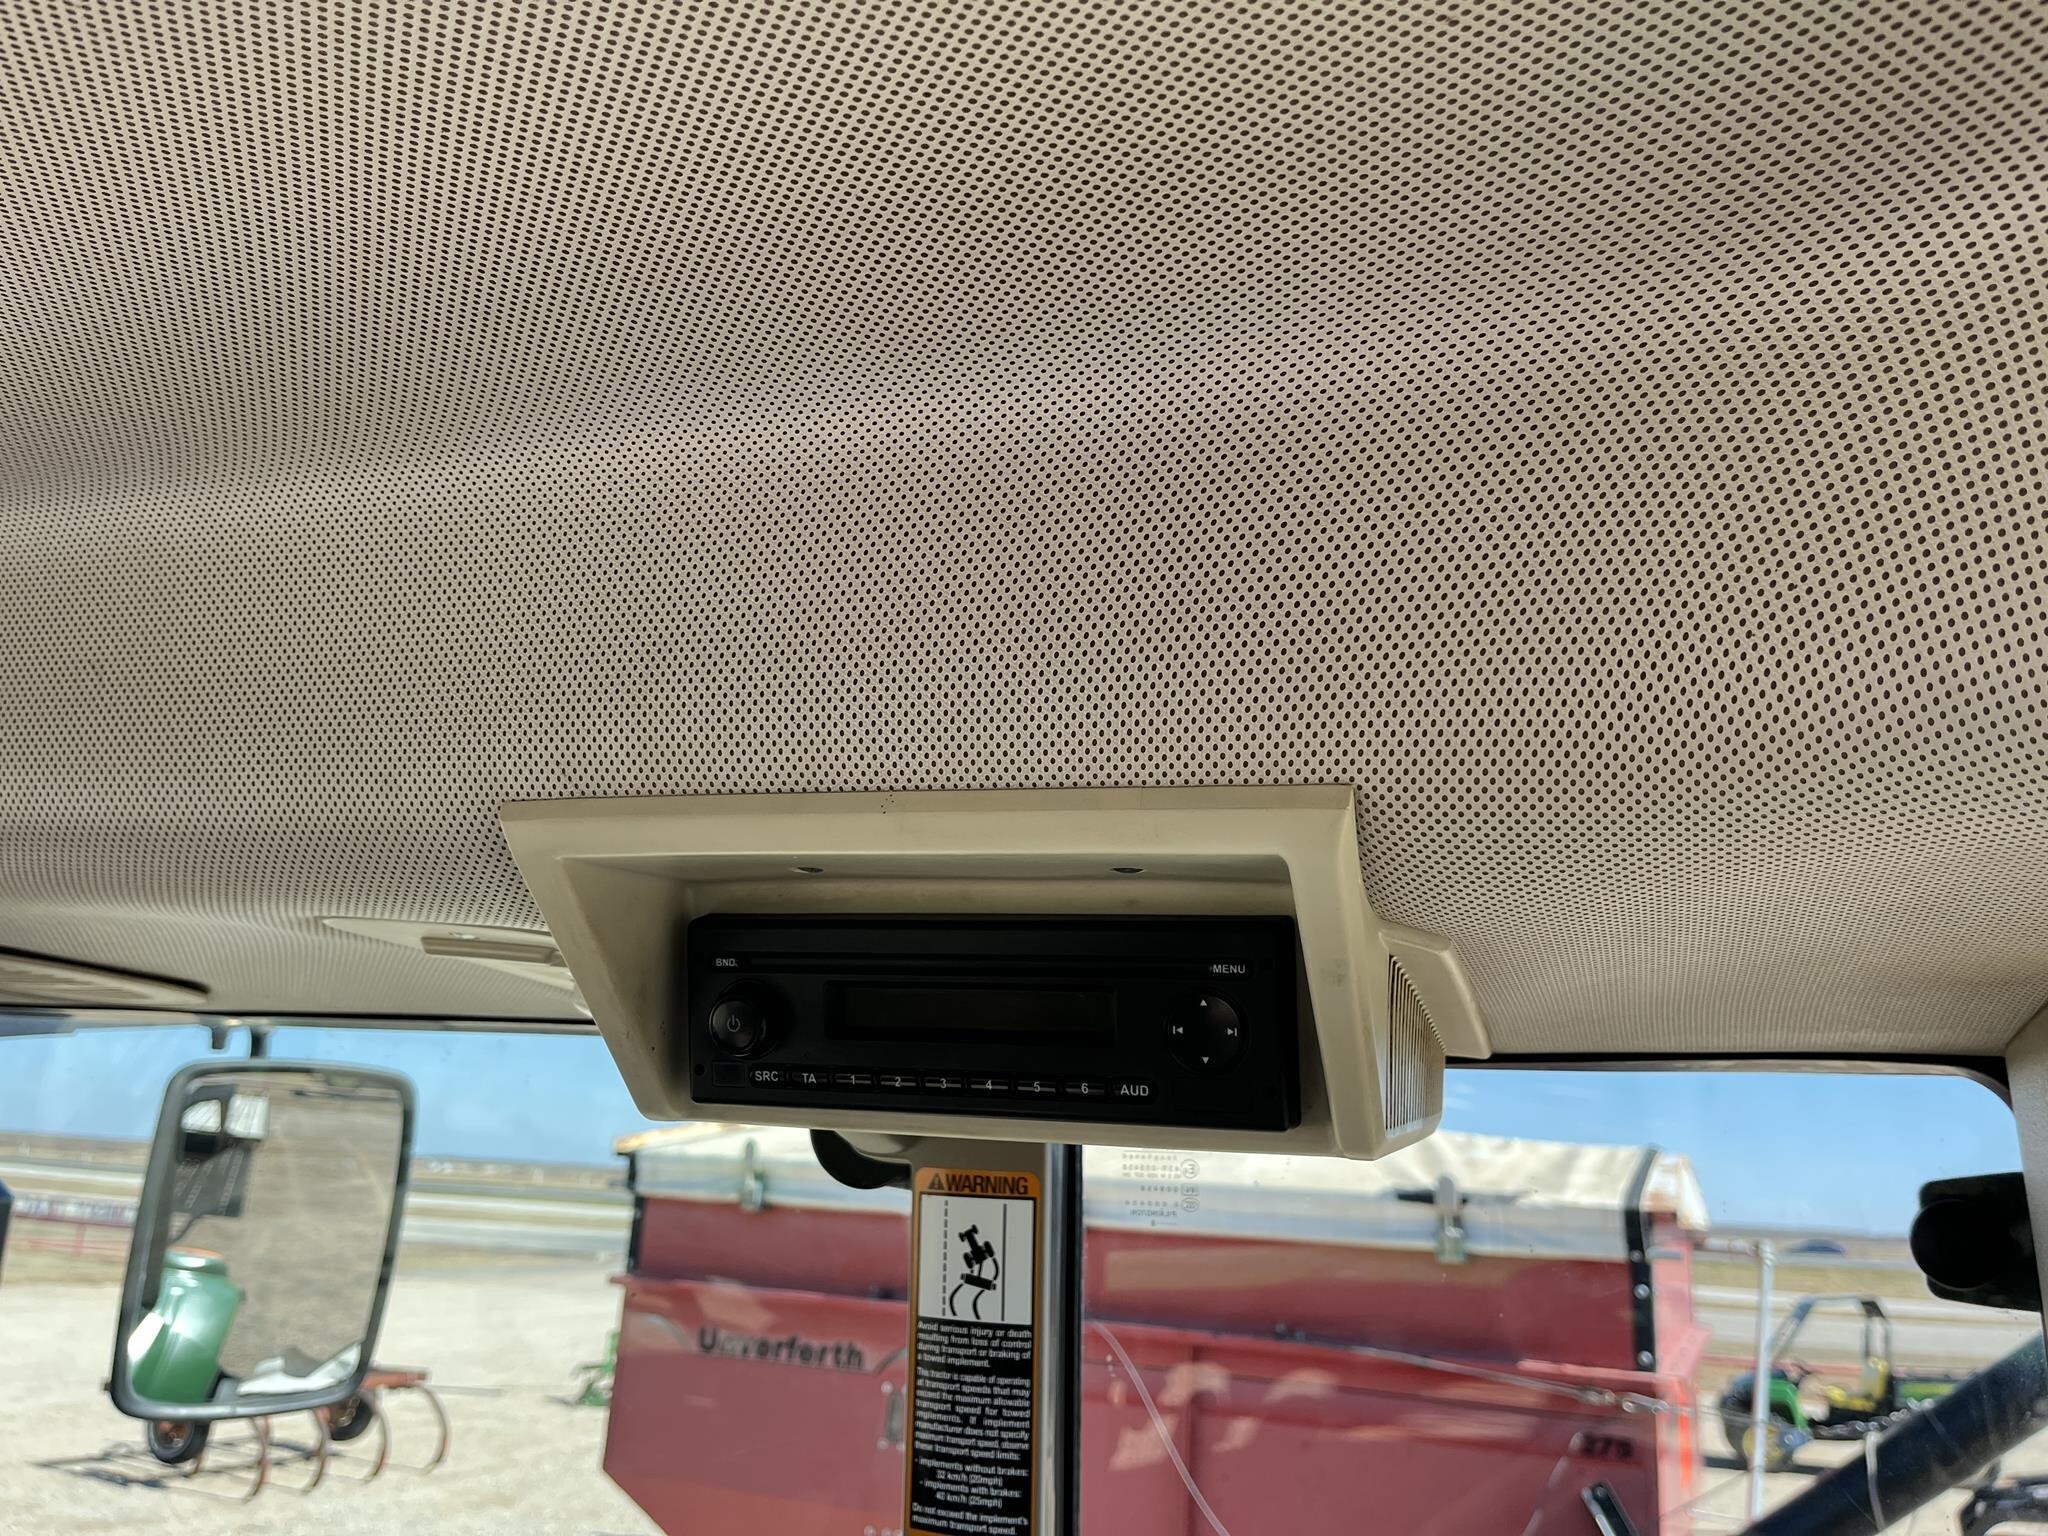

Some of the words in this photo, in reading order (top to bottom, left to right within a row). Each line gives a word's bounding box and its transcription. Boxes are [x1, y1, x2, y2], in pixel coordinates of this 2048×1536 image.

[1212, 963, 1246, 974] MENU
[754, 1070, 779, 1083] SRC
[801, 1072, 817, 1086] TA
[849, 1074, 857, 1086] 1
[894, 1076, 902, 1088] 2
[939, 1077, 947, 1090] 3
[984, 1079, 994, 1091] 4
[1032, 1081, 1041, 1093] 5
[1080, 1083, 1090, 1095] 6
[1120, 1083, 1150, 1098] AUD
[946, 1173, 1029, 1195] WARNING
